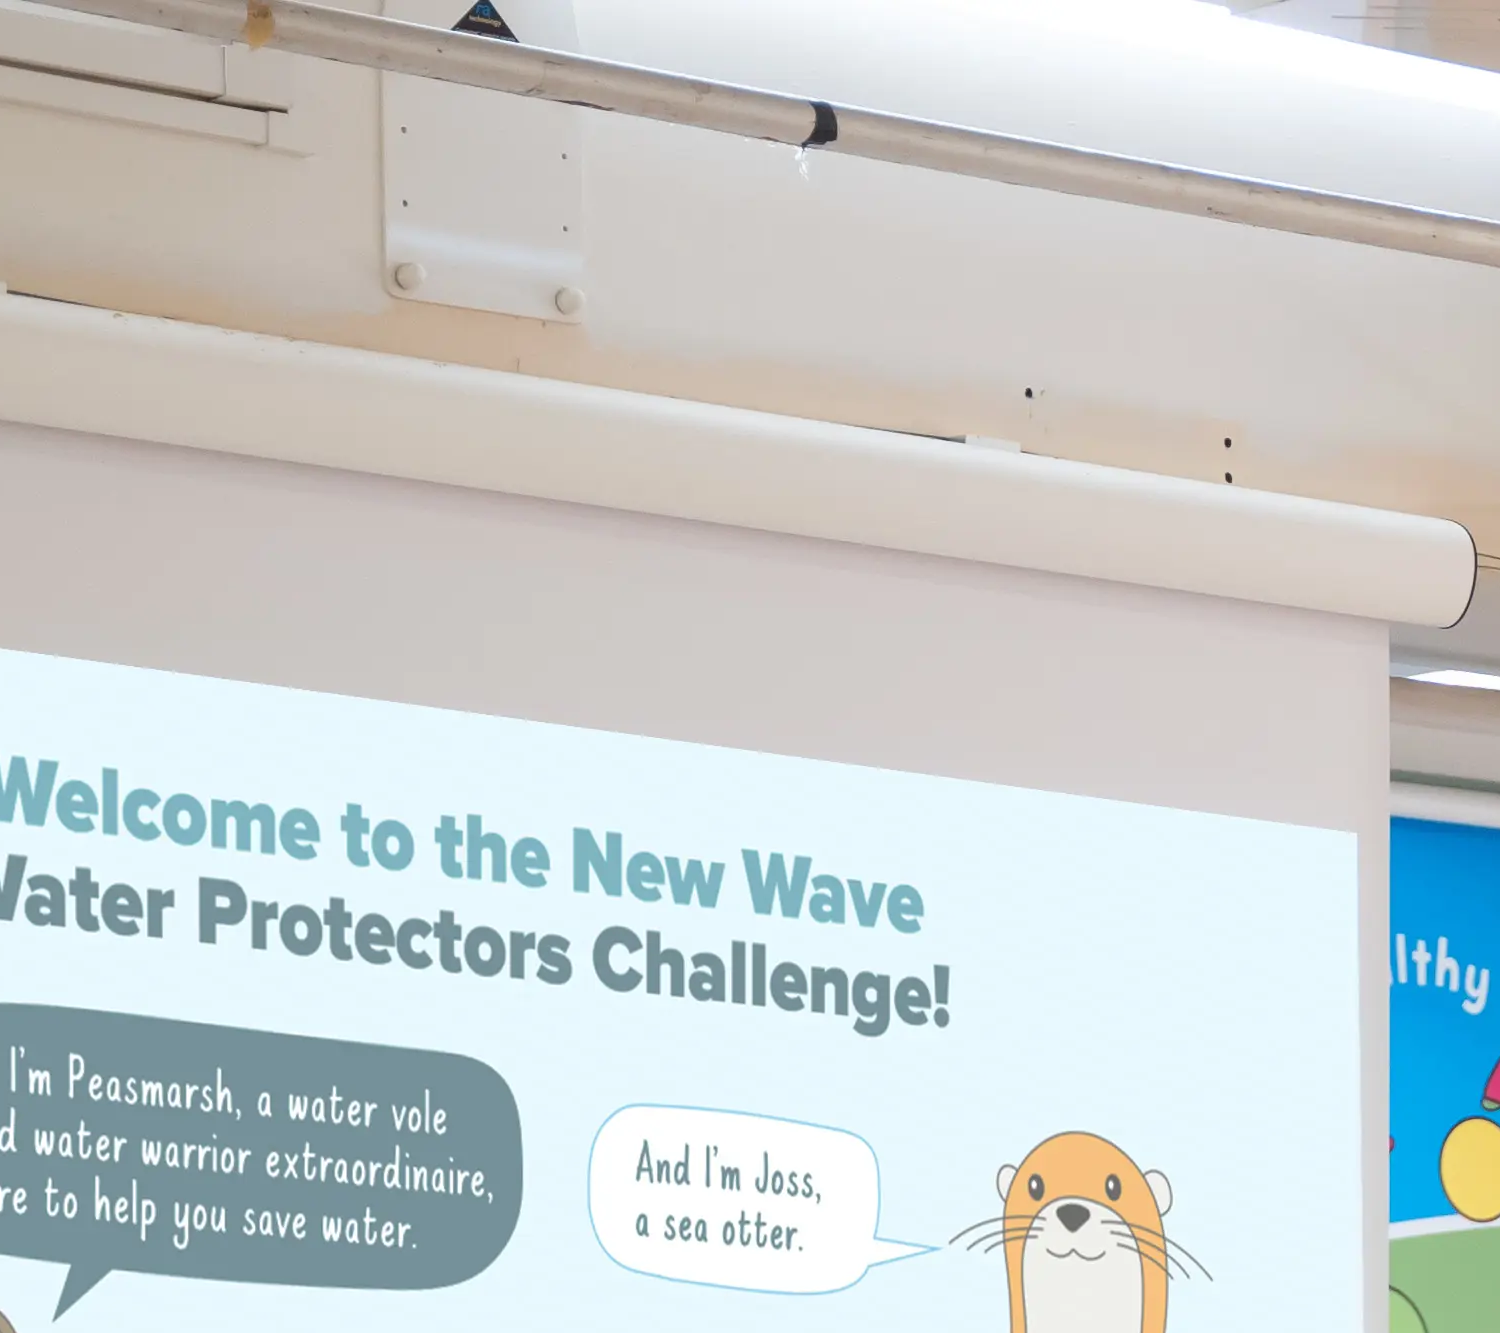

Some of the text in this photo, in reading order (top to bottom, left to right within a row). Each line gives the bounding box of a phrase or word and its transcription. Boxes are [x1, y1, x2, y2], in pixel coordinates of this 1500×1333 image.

[341, 803, 414, 871] to
[435, 814, 550, 887] the
[573, 828, 725, 908] New
[741, 849, 924, 933] Wave
[199, 877, 572, 985] Protectors
[593, 926, 949, 1037] Challenge!
[1390, 933, 1490, 1015] lthy
[11, 1046, 51, 1096] I'm
[68, 1052, 242, 1119] Peasmarsh,
[257, 1092, 272, 1117] a
[288, 1085, 378, 1127] water
[392, 1088, 447, 1135] vole
[34, 1120, 128, 1162] water
[141, 1134, 252, 1174] warrior
[266, 1142, 494, 1202] extraordinaire,
[635, 1139, 822, 1204] And I'm Joss,
[44, 1177, 78, 1219] to
[94, 1175, 156, 1242] help
[173, 1202, 226, 1250] you
[242, 1208, 306, 1239] save
[322, 1207, 419, 1249] water.
[635, 1210, 804, 1252] a sea otter.
